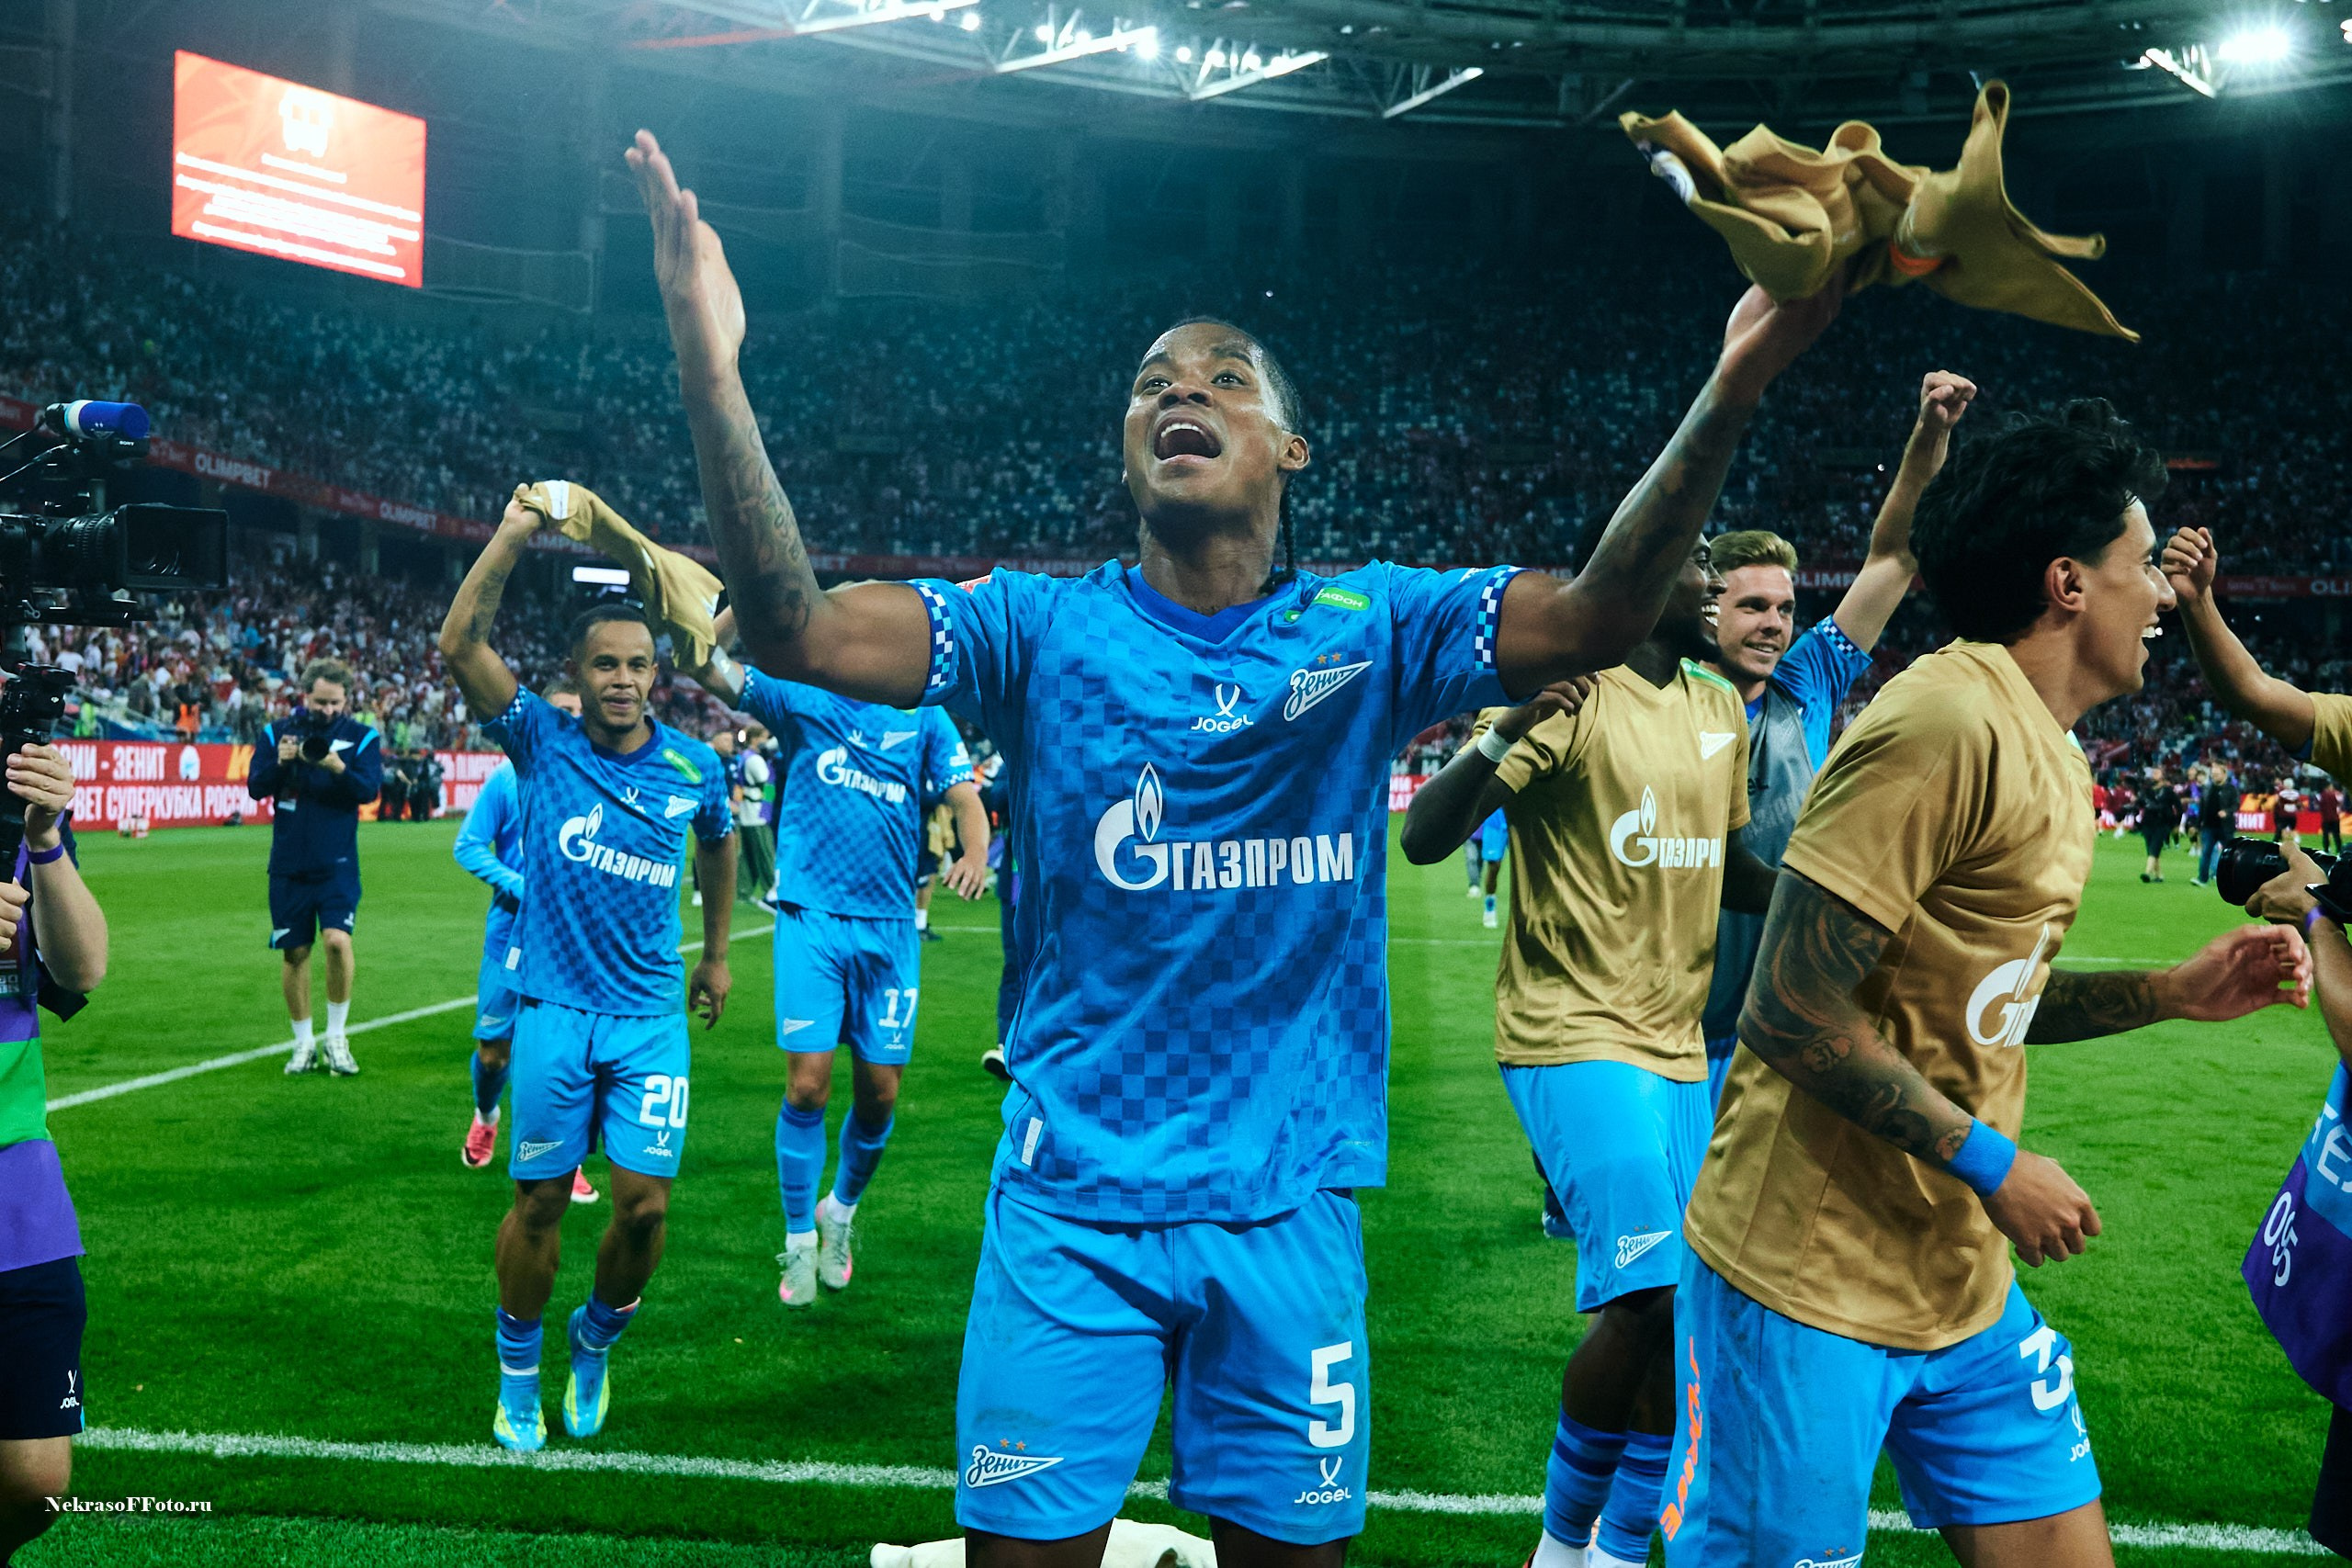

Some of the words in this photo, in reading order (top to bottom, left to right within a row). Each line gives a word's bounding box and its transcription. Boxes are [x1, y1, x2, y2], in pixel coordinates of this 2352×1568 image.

[195, 453, 271, 489] OLIMPBET
[112, 745, 167, 781] ЗЕНИТ
[107, 784, 202, 820] СУПЕРКУБКА
[590, 844, 677, 888] ГАЗПРОМ
[1172, 832, 1353, 891] ГАЗПРОМ
[878, 987, 919, 1029] 17
[639, 1074, 690, 1129] 20
[1308, 1340, 1356, 1449] 5
